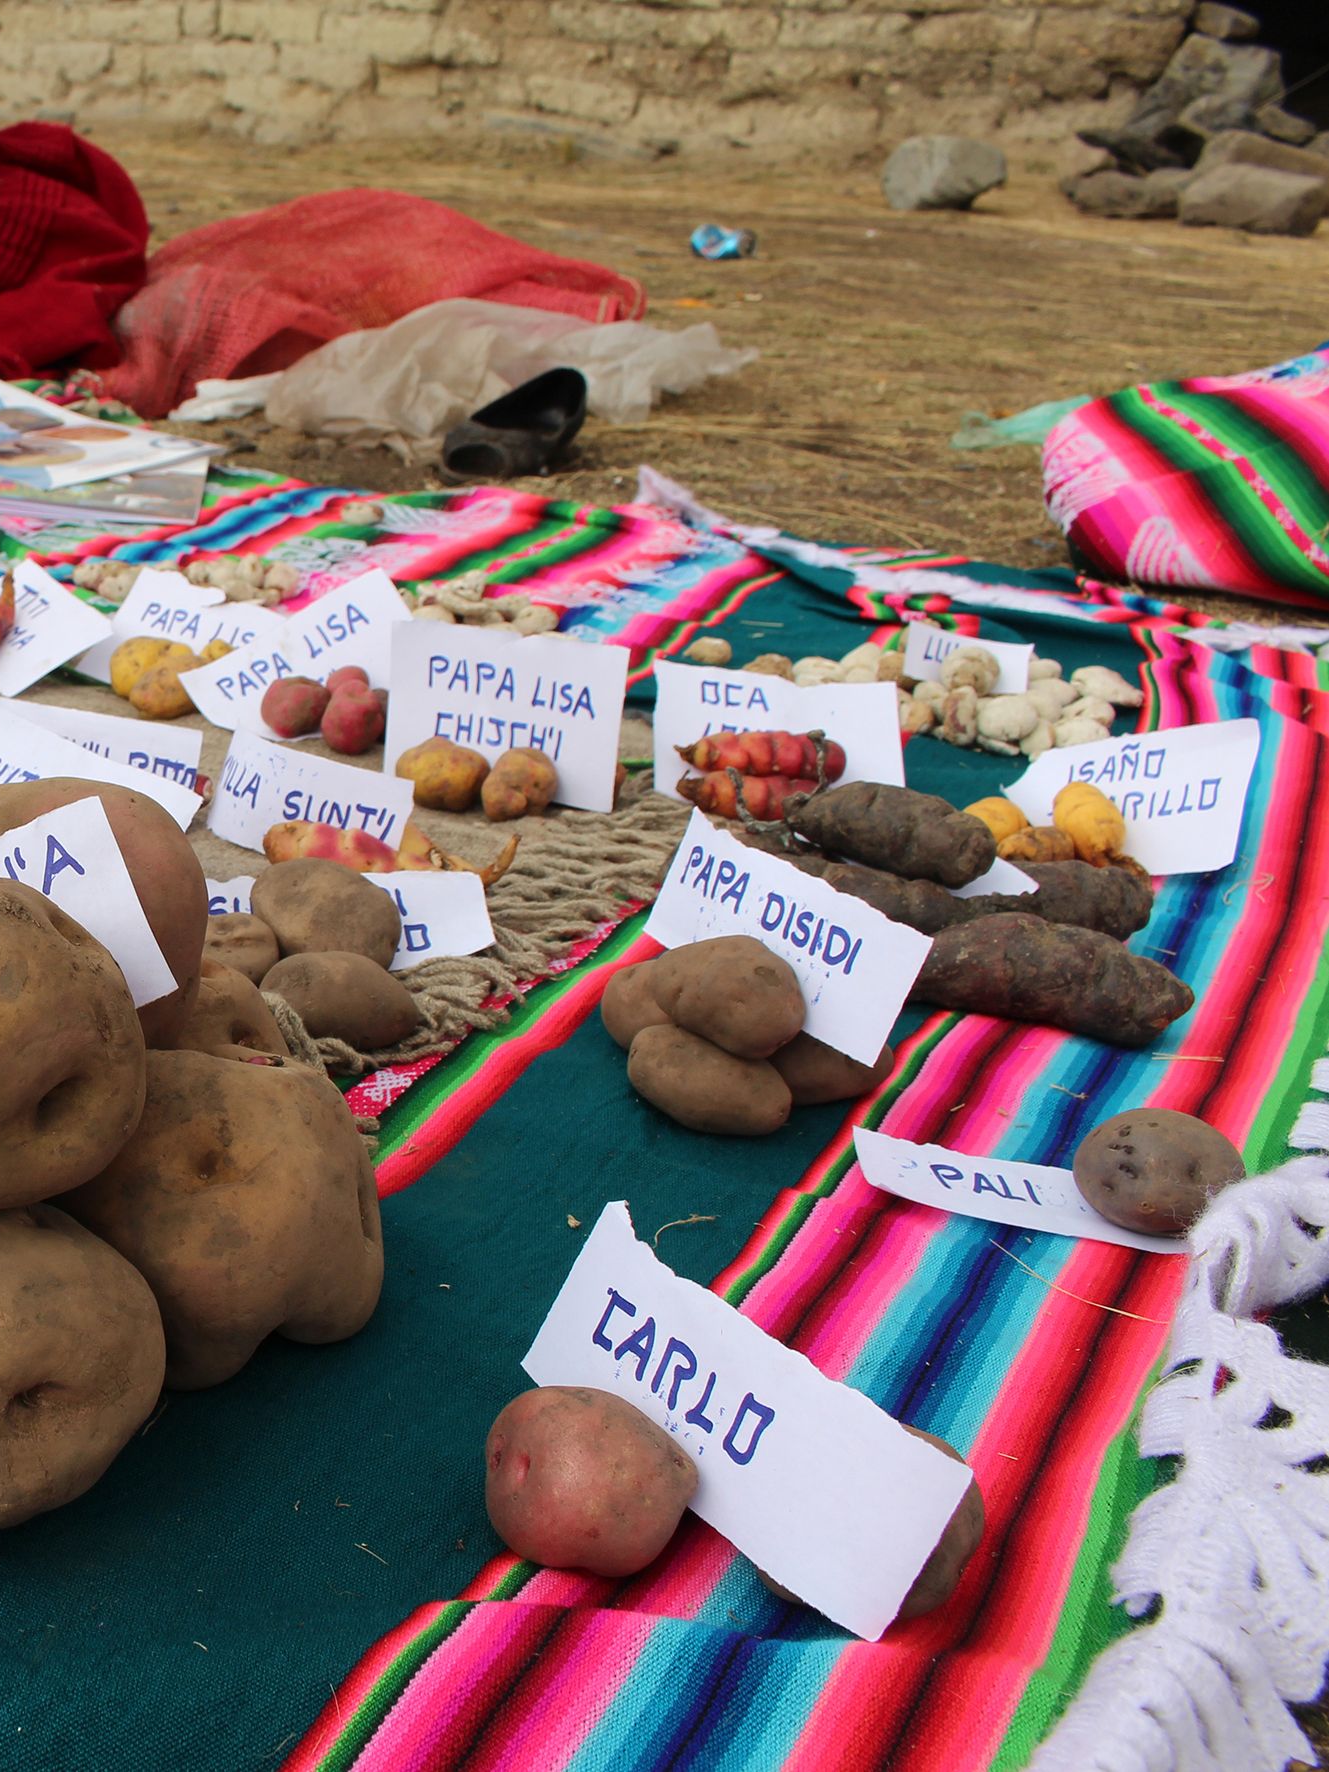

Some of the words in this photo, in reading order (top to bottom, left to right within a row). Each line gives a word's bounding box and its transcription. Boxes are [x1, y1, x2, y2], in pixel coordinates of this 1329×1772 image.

[140, 602, 202, 639] PAPA
[209, 622, 256, 650] LIS
[216, 652, 293, 701] PAPA
[303, 603, 370, 659] LISA
[429, 655, 516, 702] PAPA
[531, 676, 596, 720] LISA
[701, 680, 770, 713] OCA
[1068, 742, 1166, 784] ISAÑO
[680, 845, 751, 915] PAPA
[761, 891, 863, 975] DISIDI
[930, 1163, 1043, 1206] PALI
[592, 1289, 775, 1465] CARLO
